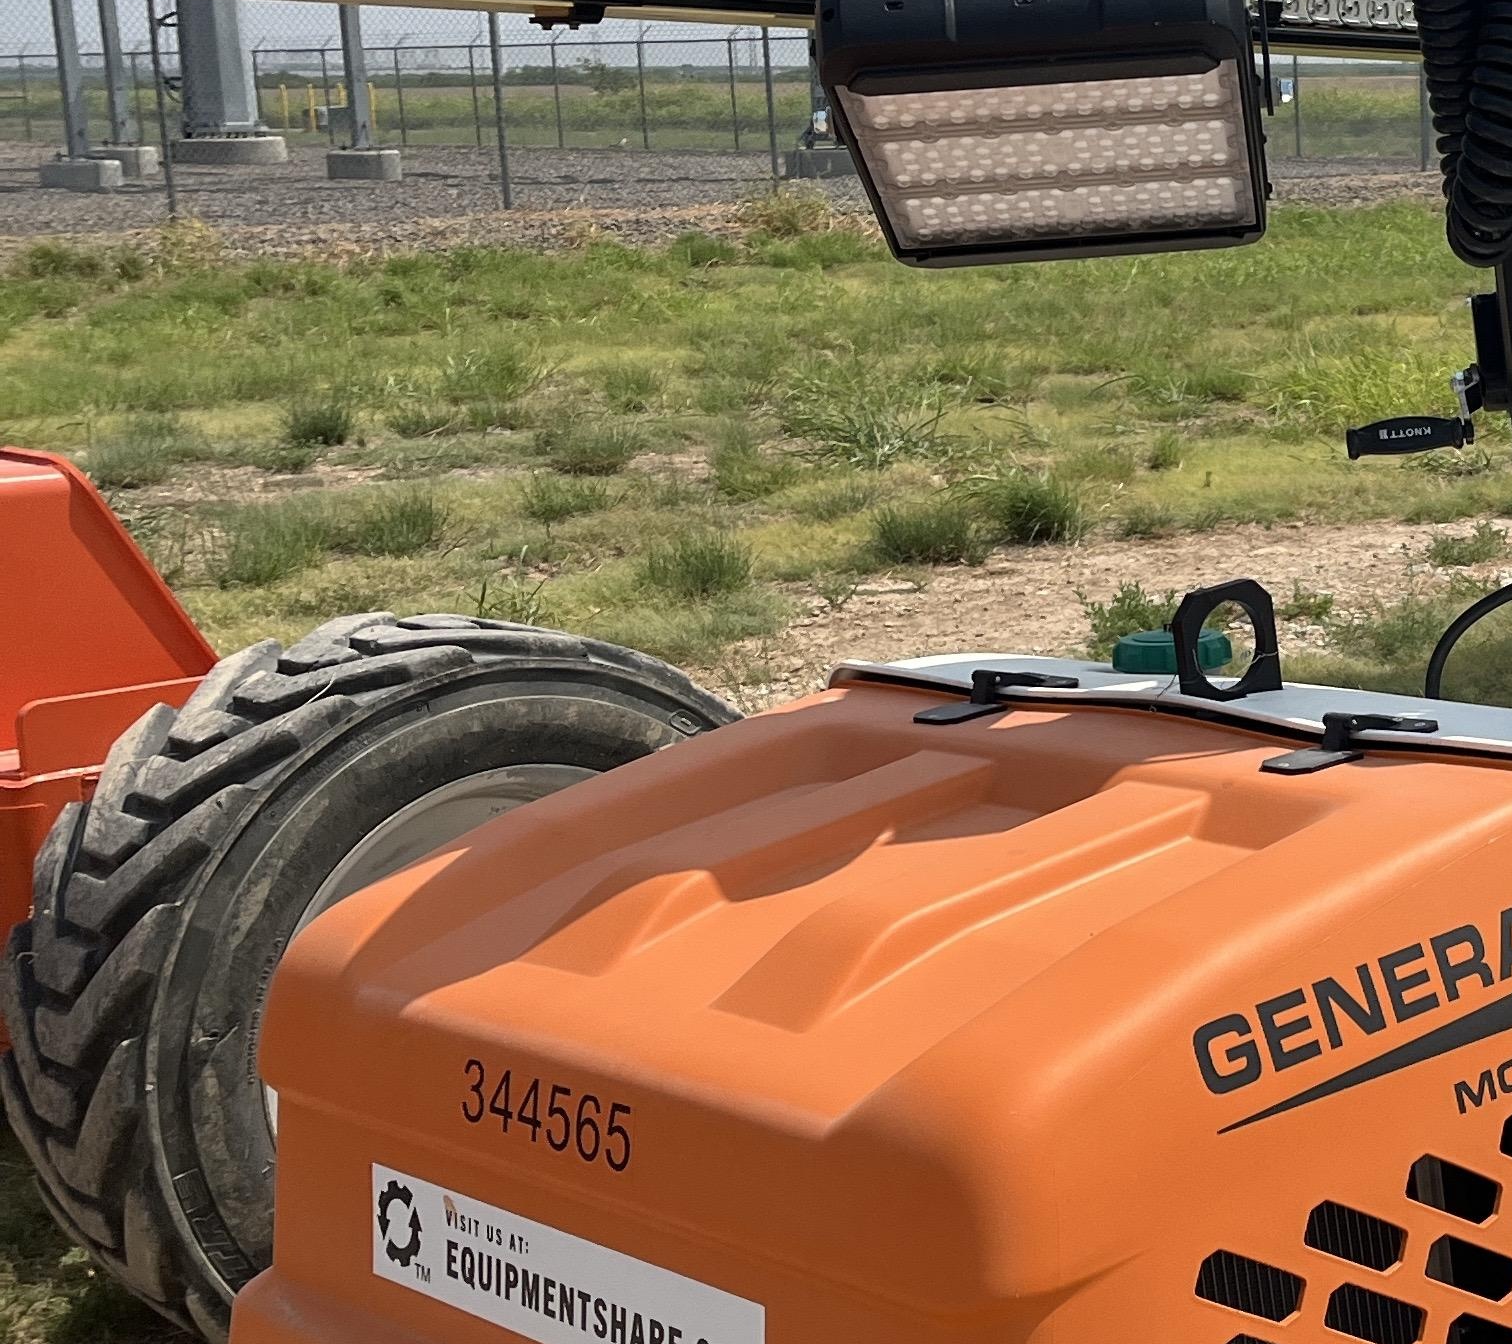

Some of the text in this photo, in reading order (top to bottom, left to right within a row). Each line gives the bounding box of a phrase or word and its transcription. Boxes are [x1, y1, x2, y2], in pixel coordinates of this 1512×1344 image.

[461, 1058, 633, 1174] 344565
[444, 1208, 529, 1255] VISIT US AT:
